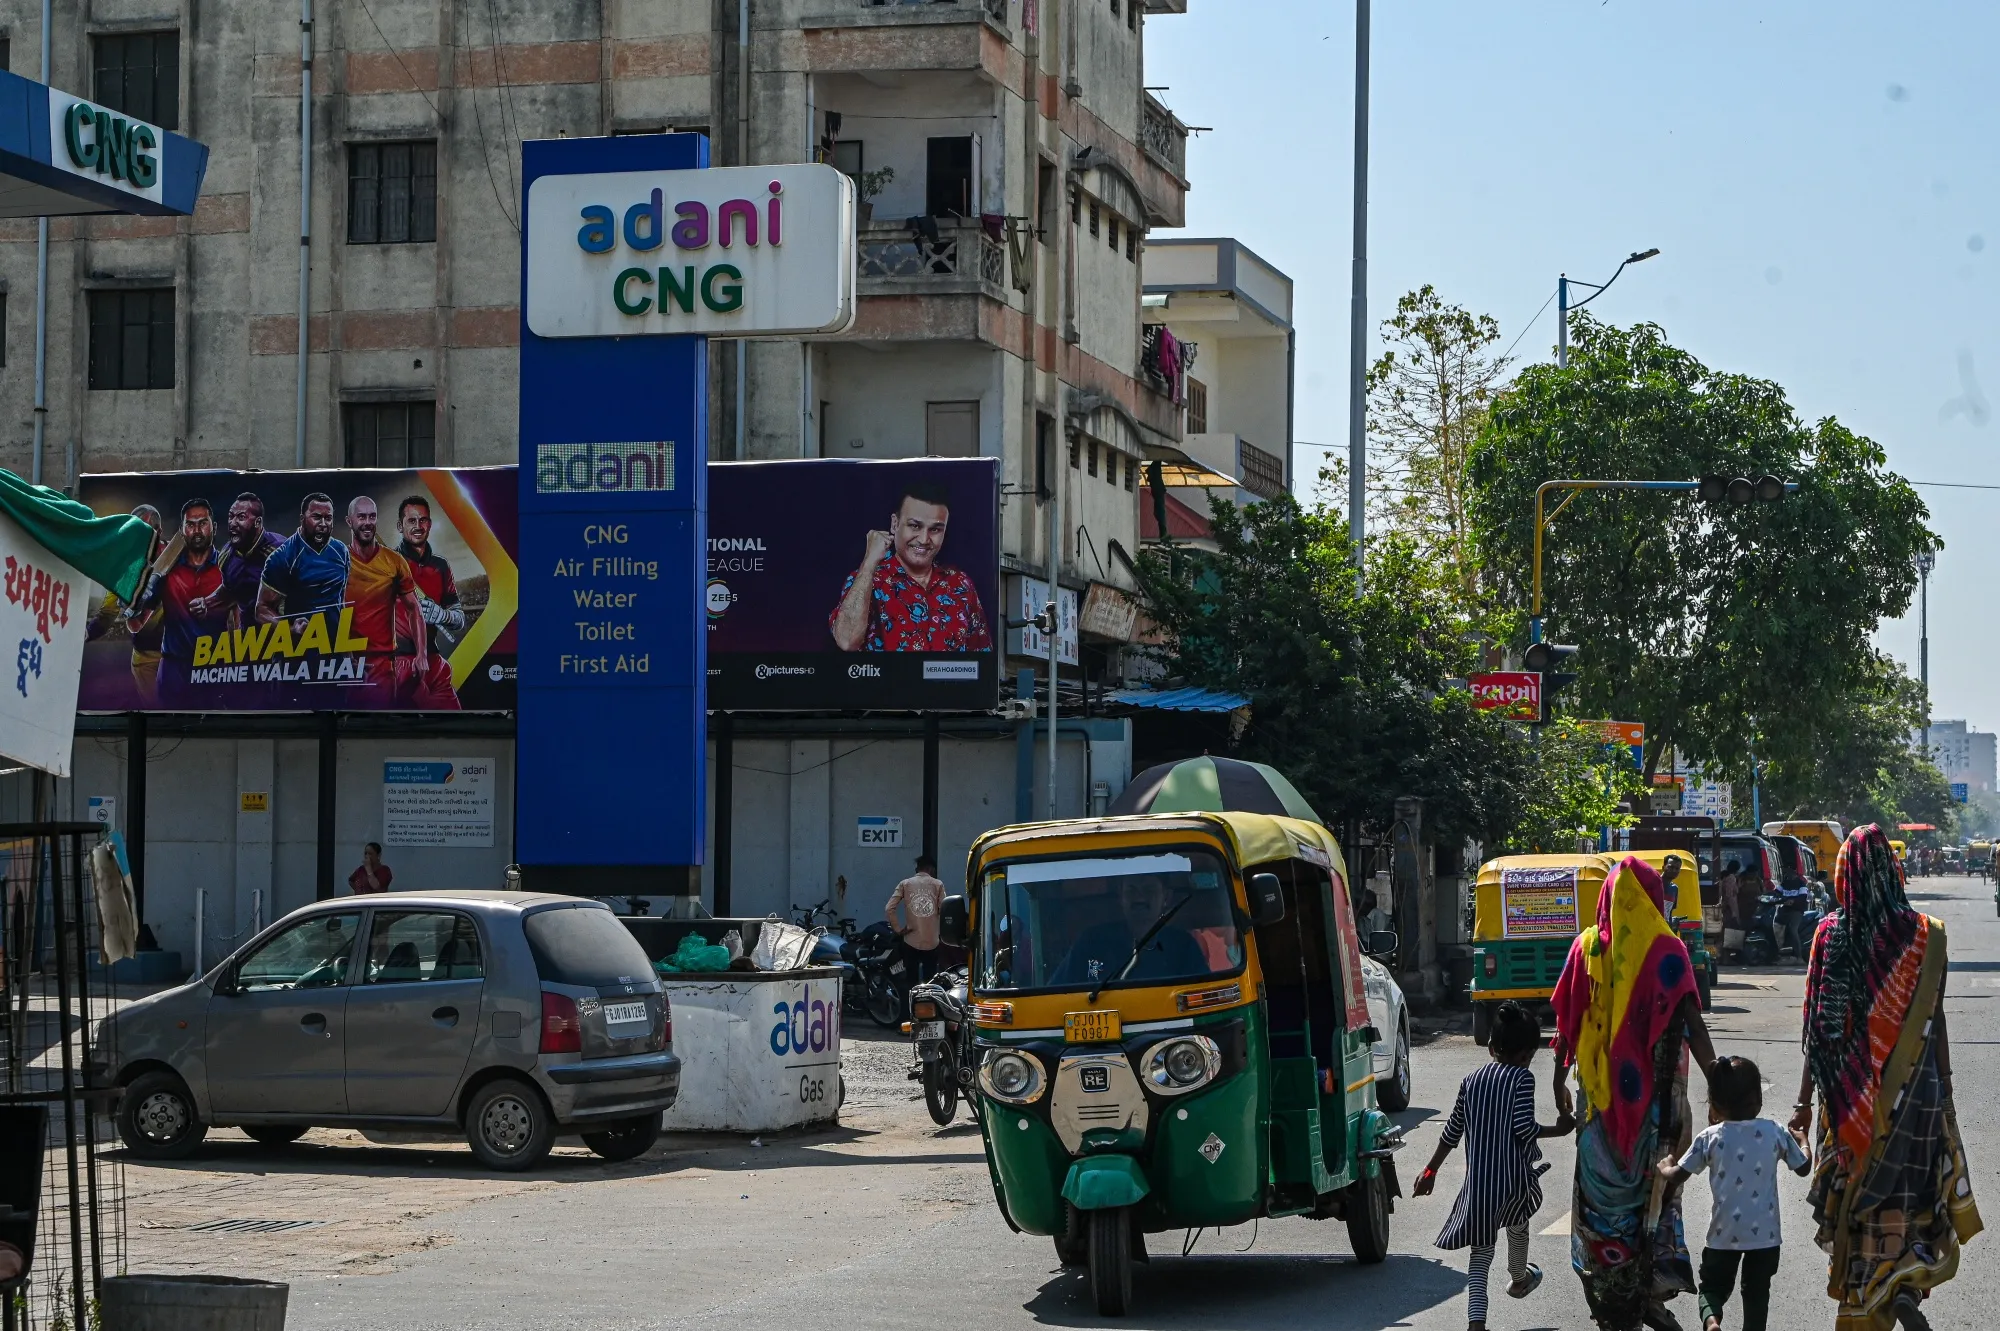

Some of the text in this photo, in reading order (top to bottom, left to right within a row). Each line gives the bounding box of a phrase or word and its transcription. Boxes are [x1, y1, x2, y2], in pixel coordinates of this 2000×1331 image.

[65, 103, 157, 189] CNG
[577, 179, 785, 254] adani
[613, 263, 745, 316] CNG
[537, 442, 665, 491] adani
[584, 525, 628, 545] CNG
[554, 557, 659, 580] Air Filling
[573, 590, 637, 609] Water
[192, 607, 369, 667] BAWAAL
[575, 621, 635, 641] Toilet
[190, 657, 366, 684] MACHNE WALA HAI
[560, 653, 649, 673] First Aid
[462, 765, 487, 775] adani
[862, 829, 899, 843] EXIT
[1073, 1013, 1109, 1027] GJ01T
[1074, 1026, 1110, 1040] F0987
[800, 1074, 824, 1104] Gas
[1085, 1073, 1105, 1086] RE
[1204, 1143, 1221, 1153] CNG
